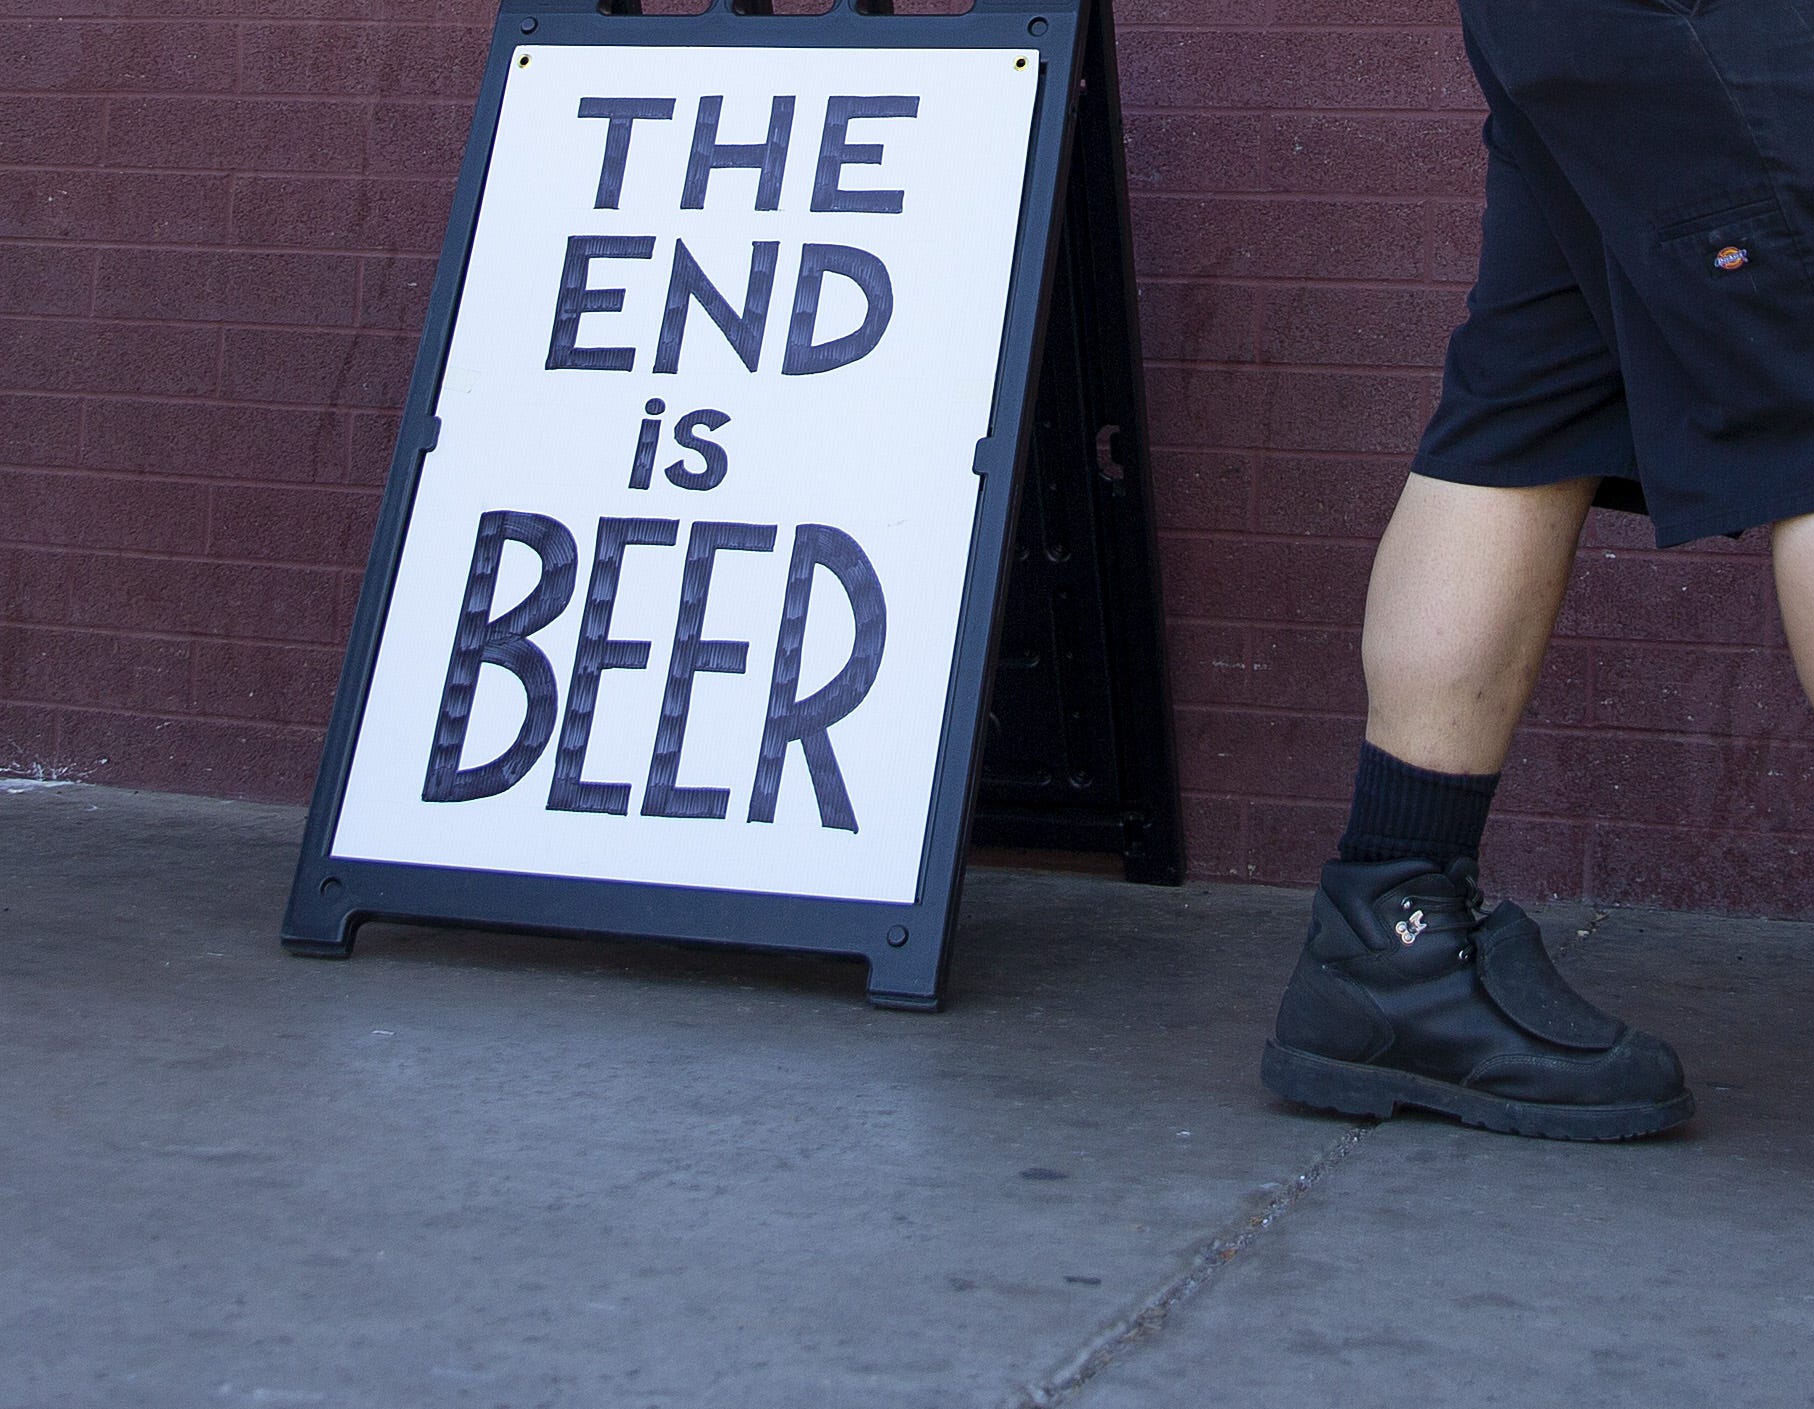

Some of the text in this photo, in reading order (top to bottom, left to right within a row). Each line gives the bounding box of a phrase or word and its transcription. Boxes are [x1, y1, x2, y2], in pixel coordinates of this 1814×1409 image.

[576, 94, 921, 214] THE
[544, 234, 895, 376] END
[627, 396, 732, 491] is
[420, 509, 887, 835] BEER
